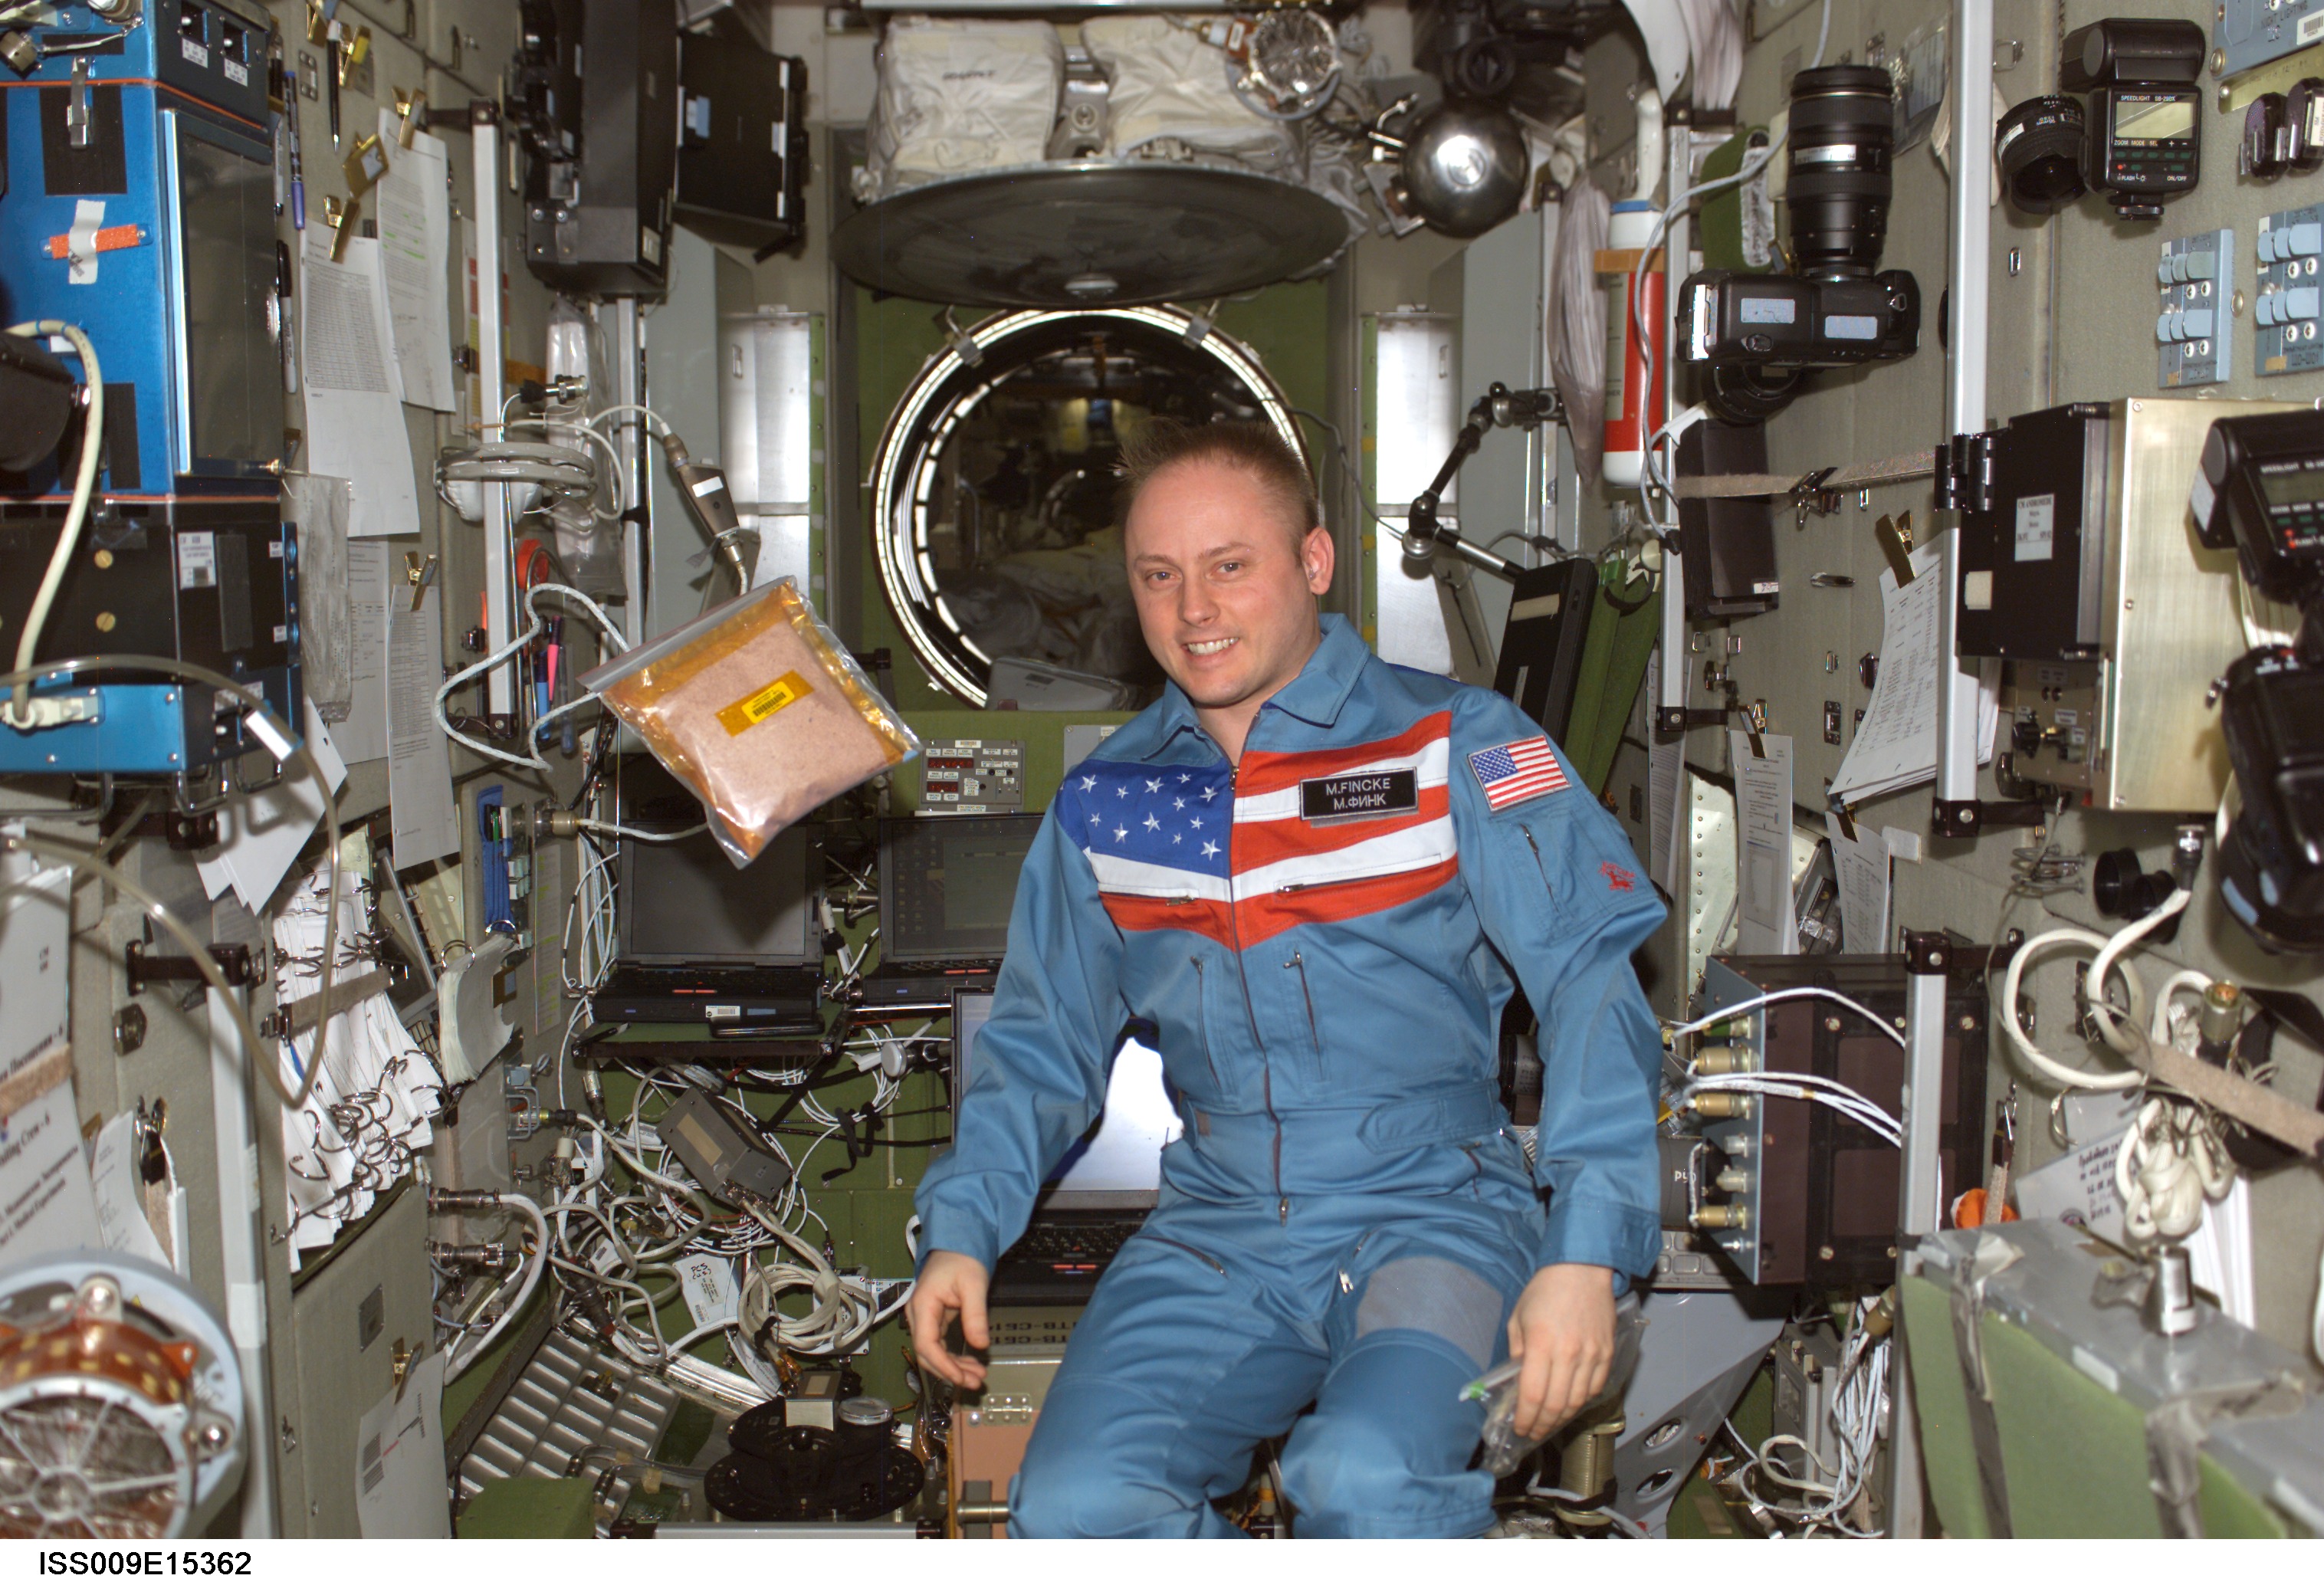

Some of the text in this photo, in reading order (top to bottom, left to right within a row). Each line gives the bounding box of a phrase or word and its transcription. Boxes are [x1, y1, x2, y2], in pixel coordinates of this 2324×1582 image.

[1325, 778, 1391, 796] M.FINCKE
[1334, 793, 1387, 810] М.ФИНК
[21, 1122, 41, 1147] Crew
[691, 1262, 707, 1272] PCS
